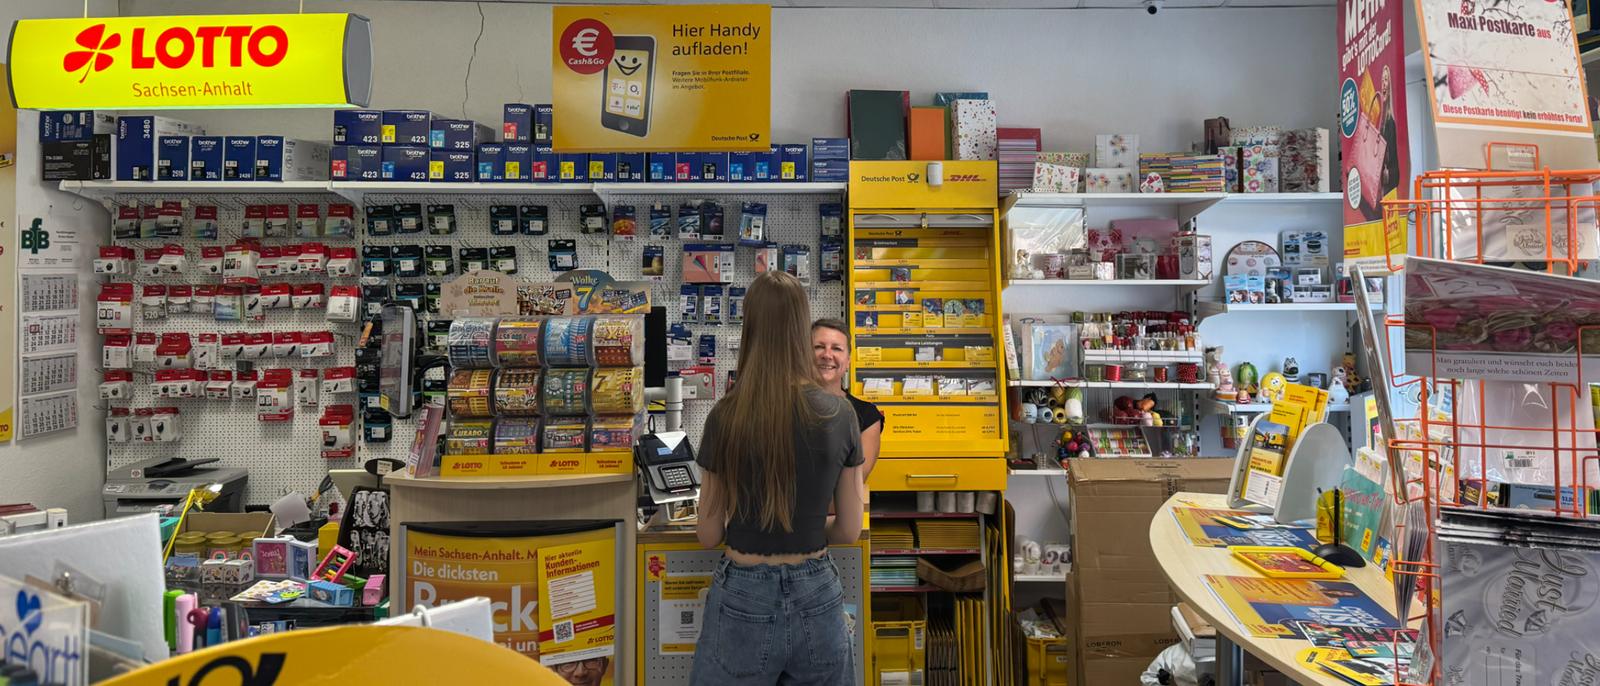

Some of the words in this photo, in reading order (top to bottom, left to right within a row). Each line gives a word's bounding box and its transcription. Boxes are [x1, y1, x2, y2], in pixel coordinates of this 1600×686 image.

[672, 23, 704, 37] Hier
[710, 22, 760, 40] Handy
[1447, 12, 1477, 31] Maxi
[1479, 16, 1535, 37] Postkarte
[1537, 28, 1552, 39] aus
[131, 25, 288, 69] LOTTO
[672, 41, 748, 55] aufladen!
[568, 57, 605, 66] Cash&Go
[132, 81, 253, 98] Sachsen-Anhalt
[1443, 103, 1463, 114] Diese
[1463, 105, 1495, 117] Postkarte
[1495, 107, 1522, 119] benötigt
[1523, 110, 1536, 120] kein
[143, 119, 151, 139] 3480
[362, 135, 378, 143] 423
[411, 135, 426, 143] 423
[454, 141, 470, 149] 325
[362, 171, 378, 179] 423
[454, 171, 470, 179] 325
[949, 174, 981, 182] DHL
[570, 275, 598, 285] Wolke
[577, 287, 594, 309] 7
[1453, 357, 1486, 367] gratuliert
[1487, 357, 1502, 365] und
[1503, 358, 1534, 367] wünscht
[1535, 359, 1554, 367] euch
[1446, 366, 1464, 374] noch
[1466, 366, 1485, 376] lange
[1511, 367, 1542, 376] schönen
[1543, 369, 1569, 377] Zeiten
[414, 546, 437, 558] Mein
[439, 547, 524, 561] Sachsen-Anhalt.
[544, 553, 557, 561] Hier
[558, 549, 582, 559] aktuelle
[545, 558, 577, 569] Kunden-
[546, 560, 600, 578] Informationen
[413, 561, 435, 577] Die
[438, 563, 498, 582] dicksten
[595, 634, 614, 642] LOTTO
